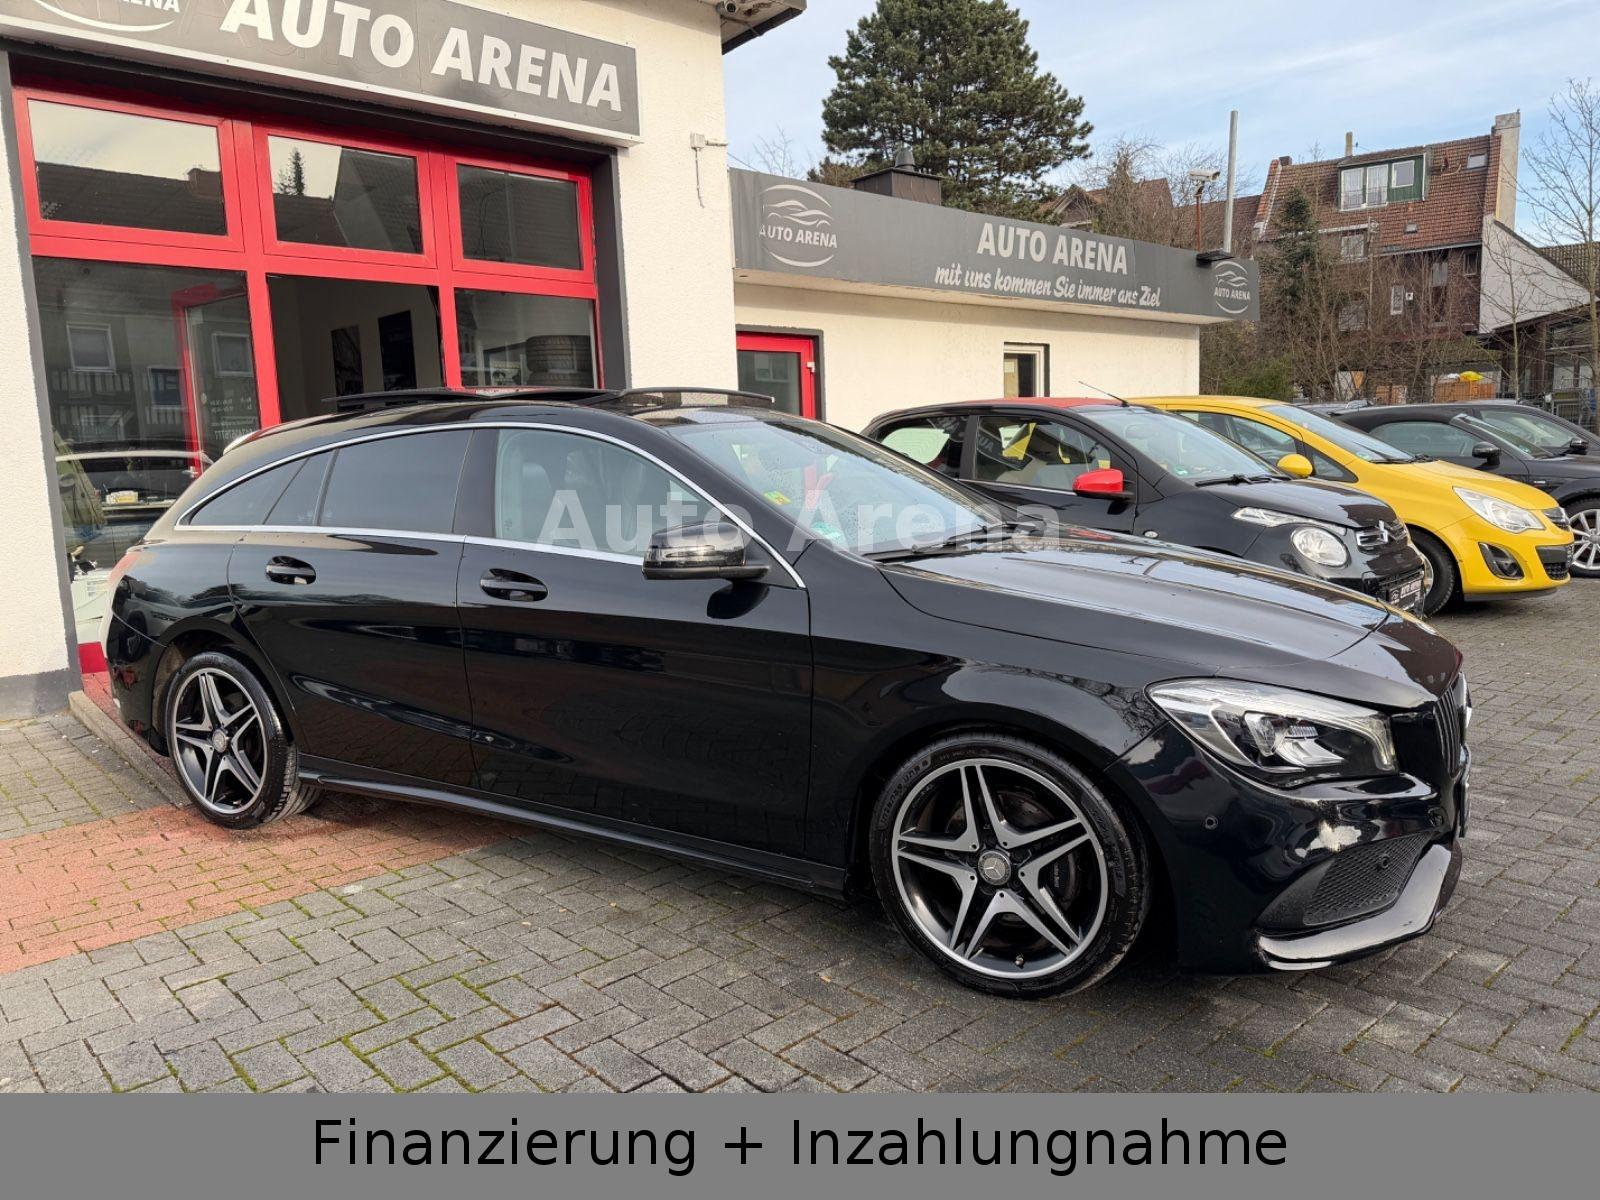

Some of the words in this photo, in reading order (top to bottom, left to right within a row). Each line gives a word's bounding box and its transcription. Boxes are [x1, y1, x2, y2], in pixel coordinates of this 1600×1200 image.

[219, 0, 415, 68] AUTO
[431, 27, 622, 112] ARENA
[759, 224, 793, 242] AUTO
[795, 229, 838, 249] ARENA
[976, 222, 1047, 263] AUTO
[1052, 234, 1128, 275] ARENA
[934, 263, 962, 286] mit
[964, 269, 991, 289] uns
[994, 268, 1052, 296] kommen
[1053, 275, 1076, 299] Sie
[1077, 280, 1117, 303] immer
[1138, 285, 1161, 307] Ziel
[1213, 286, 1230, 298] AUTO
[1230, 289, 1251, 300] ARENA
